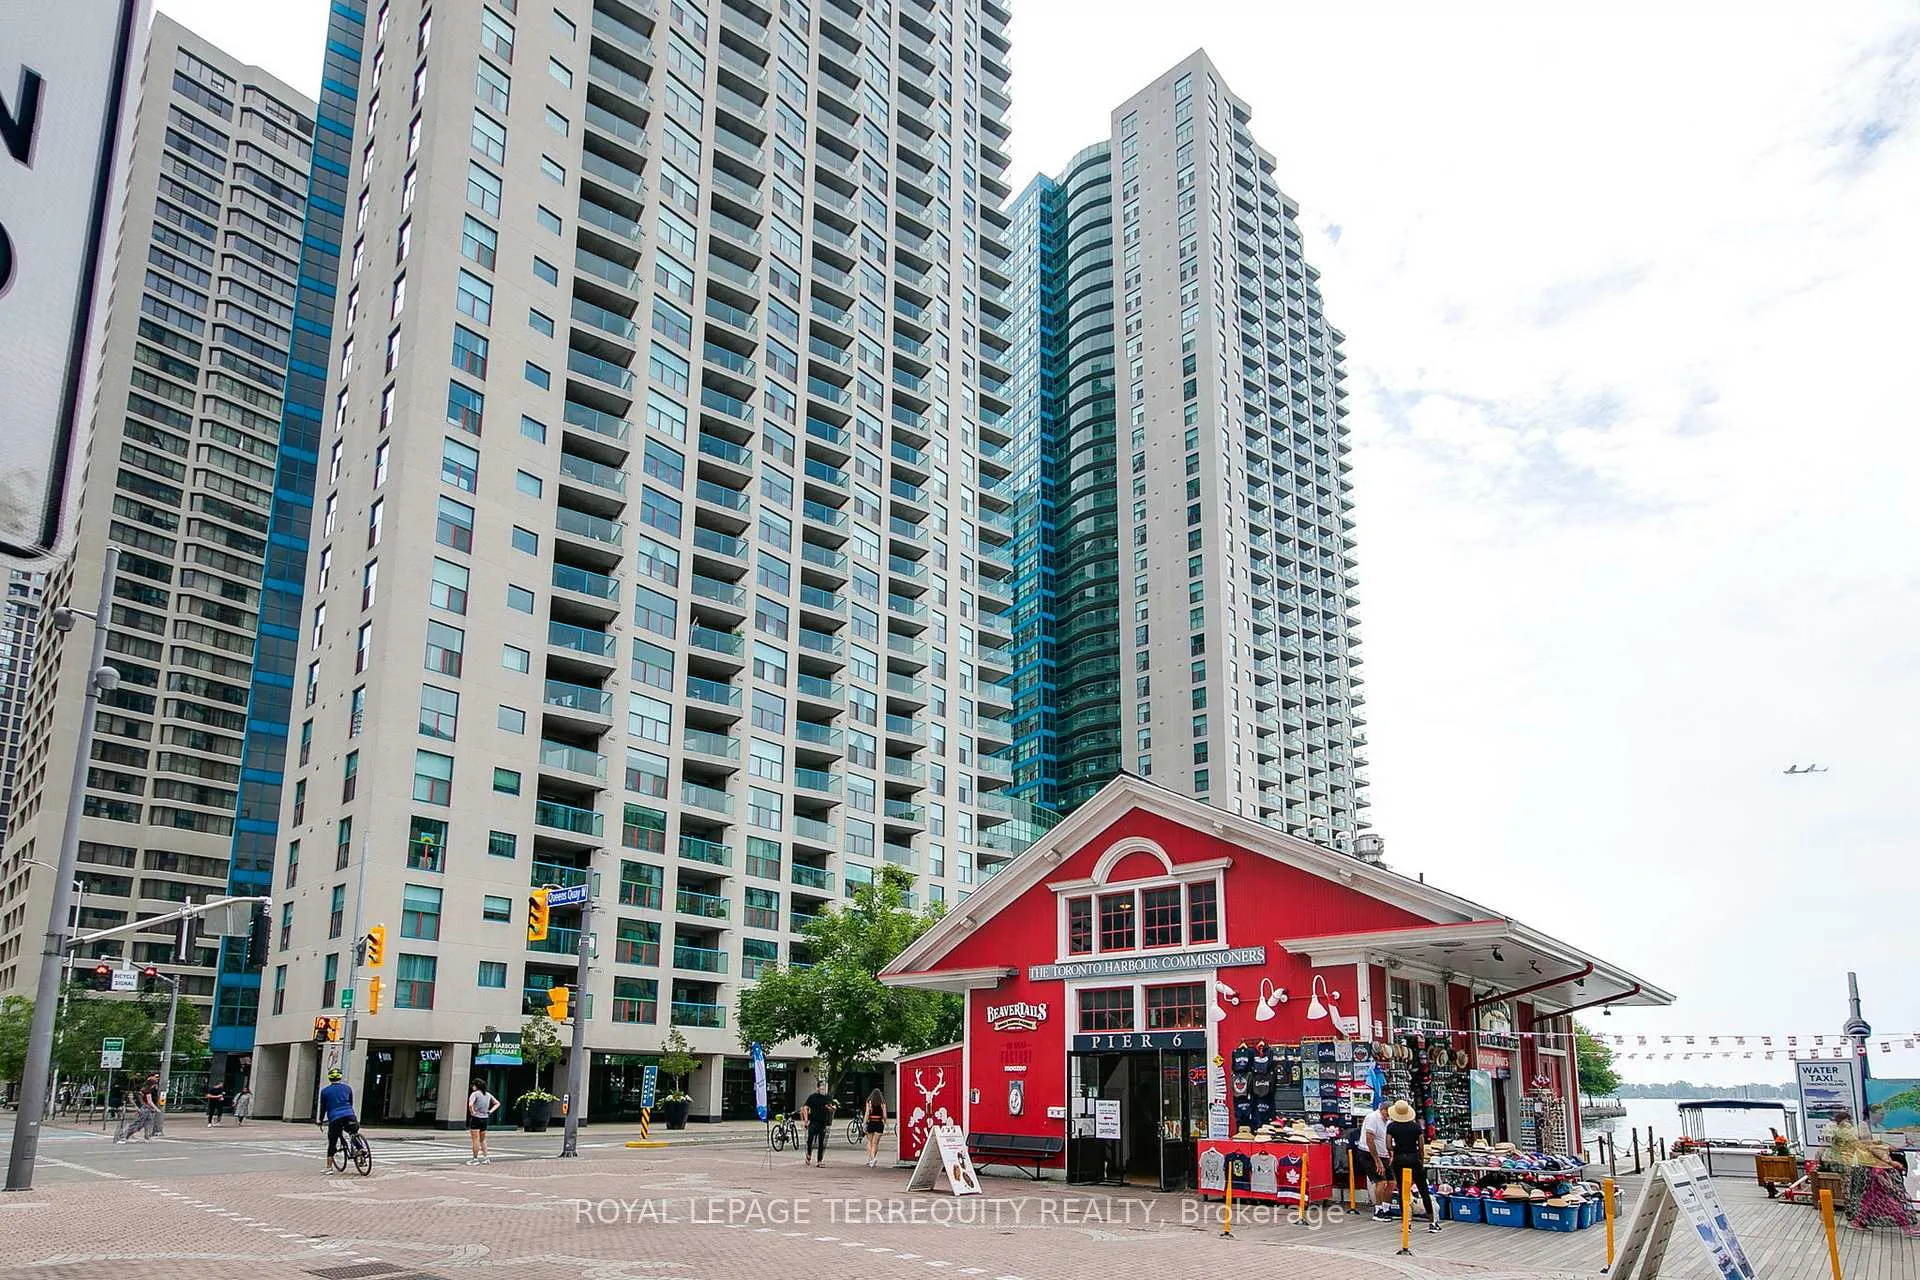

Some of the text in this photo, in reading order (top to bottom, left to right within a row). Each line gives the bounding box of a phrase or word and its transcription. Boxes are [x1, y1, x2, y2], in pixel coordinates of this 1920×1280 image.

[548, 888, 567, 903] Queens
[567, 888, 580, 901] Quay
[1030, 949, 1265, 979] THE TORONTO HARBOUR COMMISSIONERS
[1092, 1033, 1182, 1049] PIER 6
[1802, 1066, 1839, 1074] WATER
[1809, 1074, 1833, 1082] TAXI
